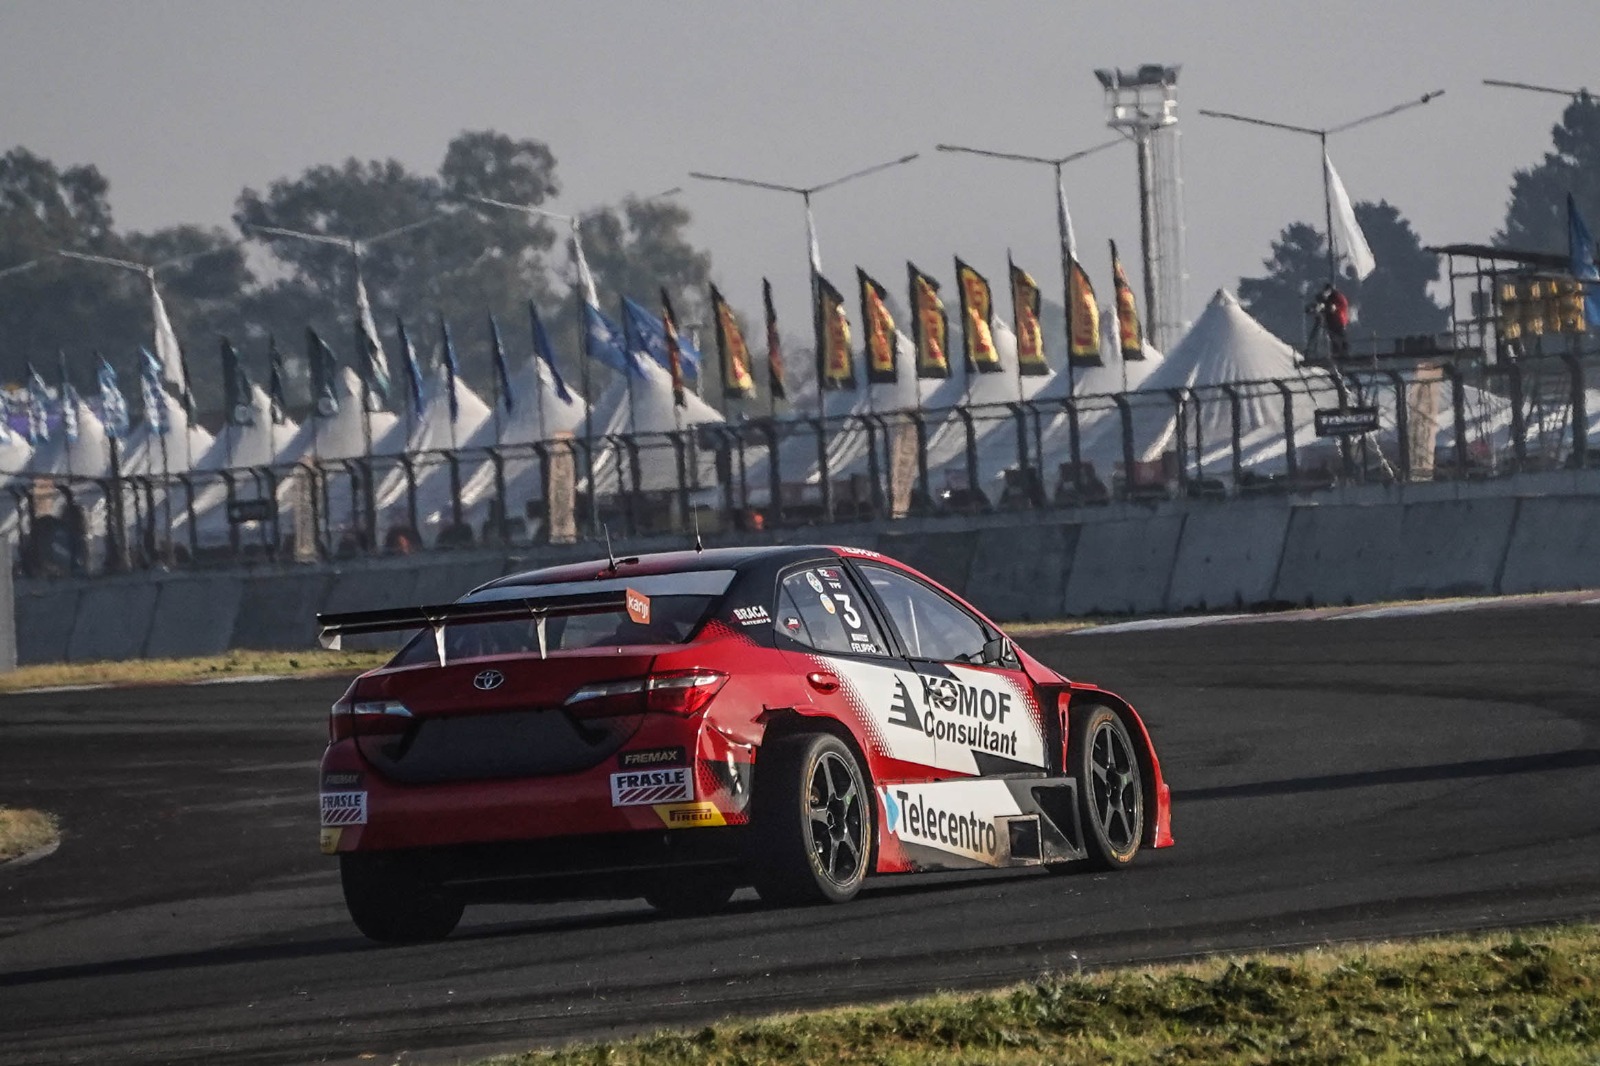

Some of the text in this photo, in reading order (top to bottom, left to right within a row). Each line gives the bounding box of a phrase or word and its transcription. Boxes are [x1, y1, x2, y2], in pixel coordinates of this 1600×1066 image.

[733, 605, 768, 620] BRACA
[833, 593, 861, 629] 3
[919, 675, 1011, 724] KOMOF
[923, 711, 1017, 756] Consultant
[624, 751, 677, 765] FREMAX
[669, 808, 711, 821] PIRELLI
[897, 790, 997, 856] Telecentro
